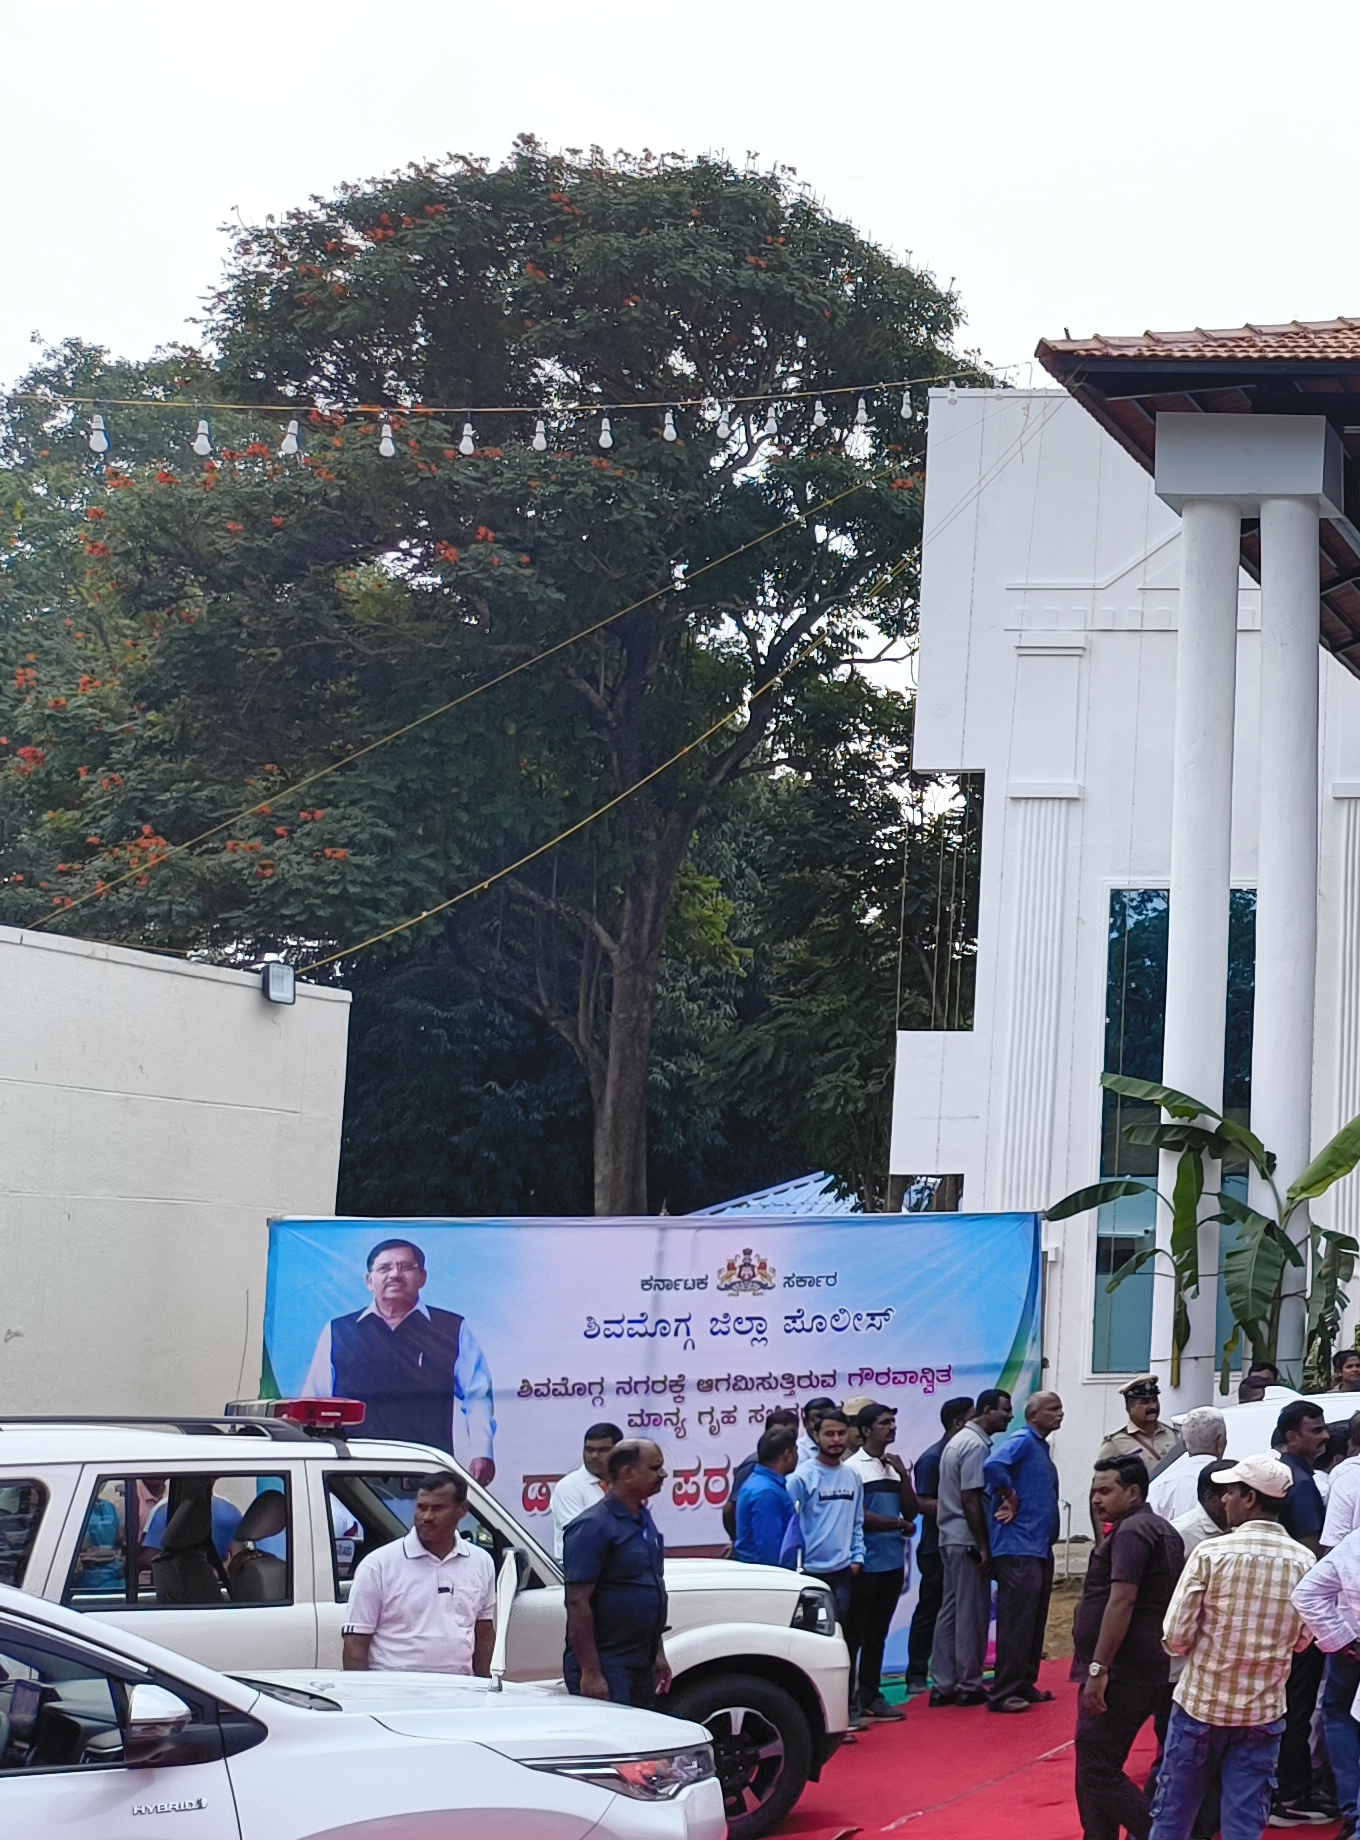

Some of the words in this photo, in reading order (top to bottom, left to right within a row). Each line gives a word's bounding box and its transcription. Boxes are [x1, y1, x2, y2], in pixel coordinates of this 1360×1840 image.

[640, 1274, 709, 1292] ಕರ್ನಾಟಕ
[782, 1271, 838, 1289] ಸರ್ಕಾರ
[583, 1312, 696, 1351] ಶಿವಮೊಗ್ಗ
[709, 1312, 769, 1347] ಜಿಲ್ಲಾ
[783, 1307, 895, 1335] ಪೊಲೀಸ್
[516, 1376, 605, 1407] ಶಿವಮೊಗ್ಗ
[615, 1373, 686, 1404] ನಗರಕ್ಕೆ
[696, 1369, 837, 1398] ಆಗಮಿಸುತ್ತಿರುವ
[847, 1364, 953, 1395] ಗೌರವಾನ್ವಿತ
[627, 1407, 688, 1440] ಮಾನ್ಯ
[697, 1405, 738, 1436] ಗೃಹ
[133, 1800, 200, 1816] HYBRID
